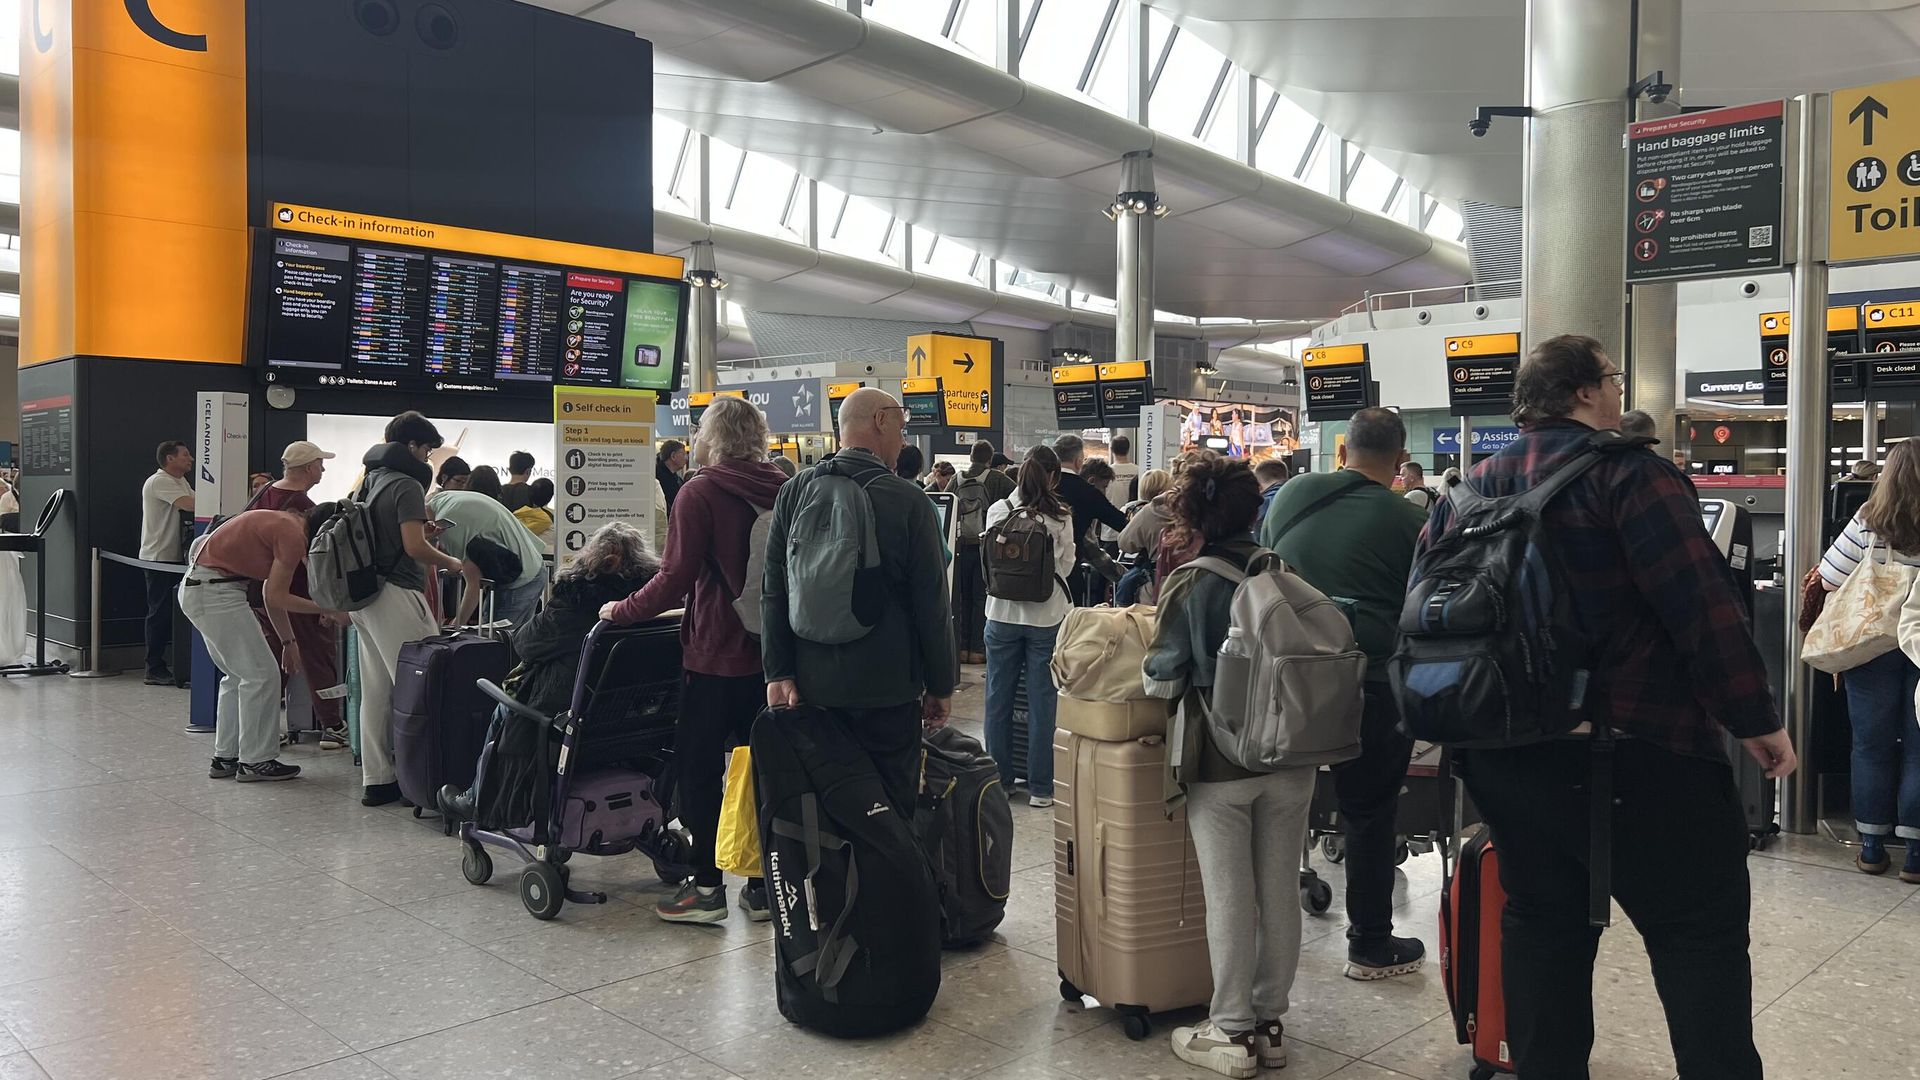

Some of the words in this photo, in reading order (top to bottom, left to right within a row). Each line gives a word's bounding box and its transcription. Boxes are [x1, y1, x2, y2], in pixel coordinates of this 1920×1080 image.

[1643, 125, 1667, 133] Prepare
[1680, 118, 1707, 127] Security
[1637, 139, 1669, 153] Hand
[1672, 131, 1726, 148] baggage
[1729, 125, 1765, 139] limits
[1716, 144, 1730, 152] your
[1687, 171, 1716, 181] carry-on
[1717, 168, 1734, 176] bags
[1748, 162, 1774, 172] person
[1681, 209, 1704, 217] sharps
[1846, 197, 1920, 233] Toil
[298, 212, 355, 228] Check-in
[360, 219, 434, 238] information
[1681, 232, 1716, 243] prohibited
[581, 297, 608, 307] Security?
[596, 293, 613, 301] ready
[1889, 308, 1914, 318] C11
[1782, 316, 1789, 326] C
[1462, 340, 1473, 348] C9
[1700, 383, 1744, 392] Currency
[1745, 381, 1764, 390] Exc
[943, 390, 979, 399] epartures
[670, 398, 689, 410] CO
[748, 393, 769, 405] YOU
[948, 400, 979, 412] Security
[576, 403, 593, 412] Self
[595, 404, 620, 413] check
[623, 404, 631, 413] in
[672, 415, 689, 426] WIT
[565, 427, 582, 435] Step
[1483, 432, 1519, 441] Assista
[1713, 465, 1733, 473] ATM
[770, 852, 791, 937] Kathmandu
